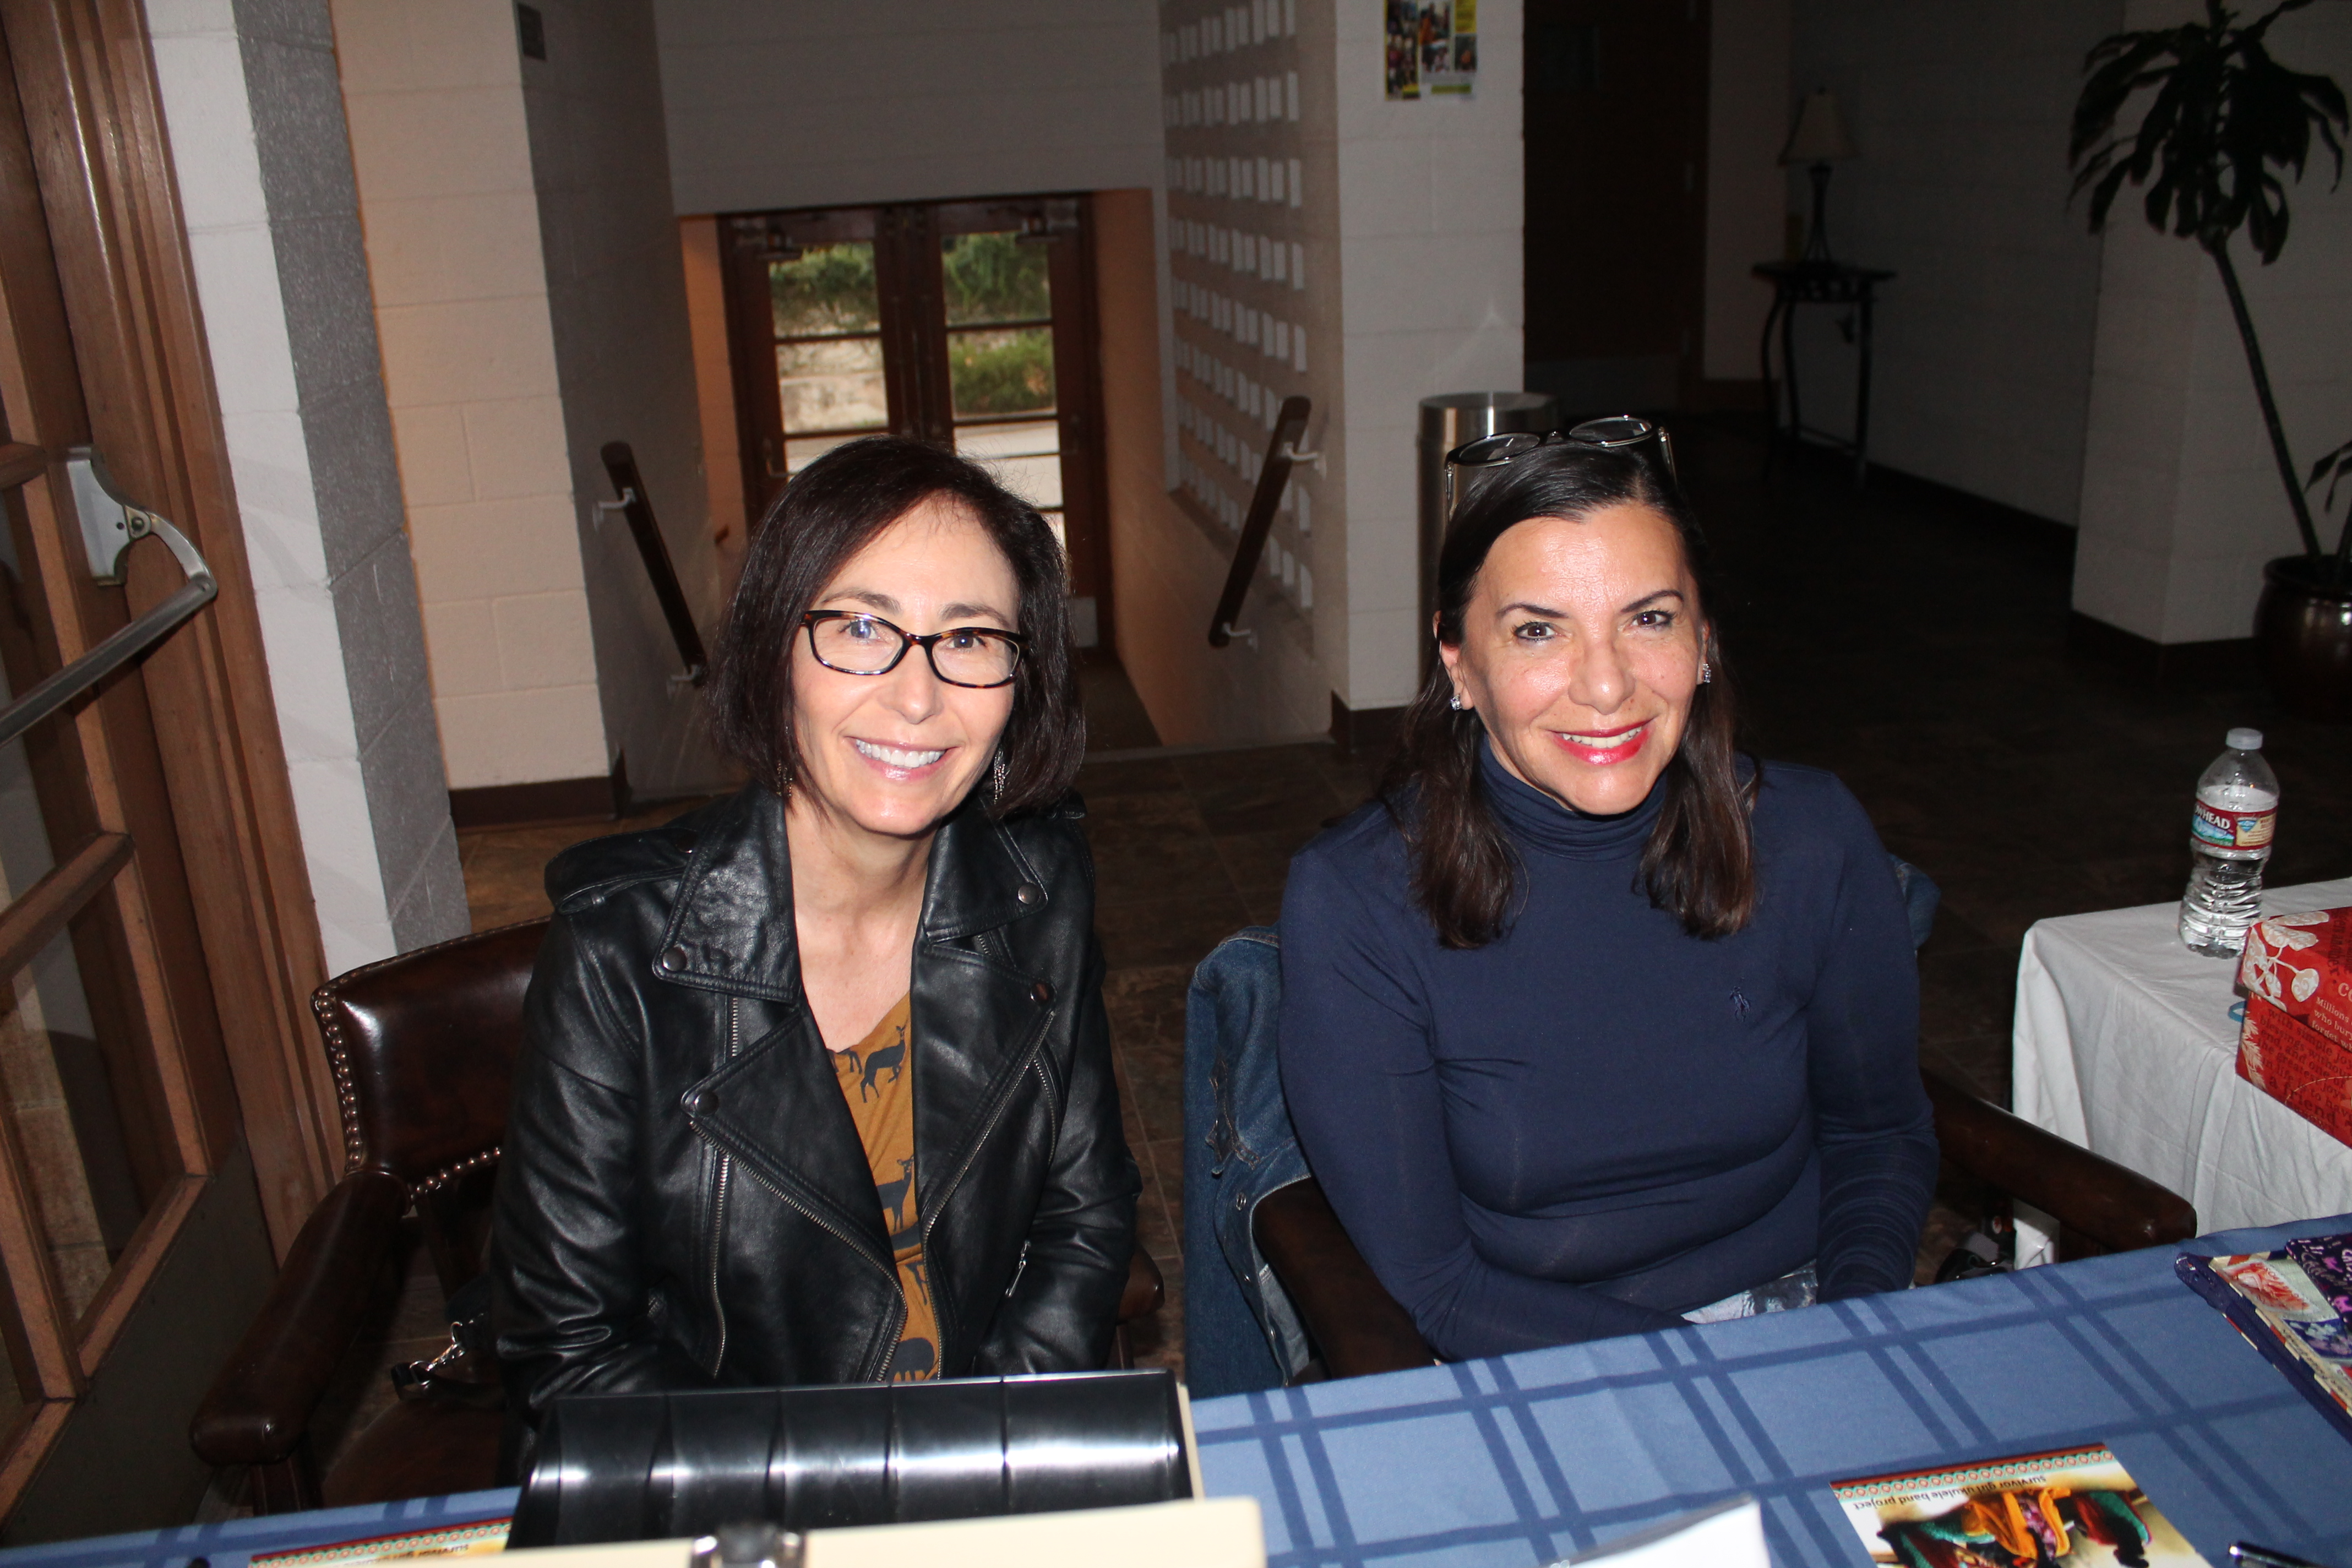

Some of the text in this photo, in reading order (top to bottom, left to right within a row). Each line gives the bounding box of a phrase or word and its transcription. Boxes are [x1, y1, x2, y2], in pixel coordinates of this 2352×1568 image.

[2195, 804, 2230, 830] WHEAD
[2314, 1010, 2333, 1026] who
[2316, 996, 2350, 1023] Millions
[2260, 1015, 2305, 1052] blessings
[2268, 1009, 2293, 1030] with
[2297, 1027, 2333, 1057] simple
[2312, 1020, 2339, 1042] forget
[2258, 1038, 2346, 1100] the greatest joys
[2285, 1047, 2307, 1064] and
[2309, 1061, 2330, 1077] one
[2262, 1057, 2273, 1070] in
[2277, 1063, 2294, 1083] life
[2311, 1087, 2322, 1101] to
[2269, 1076, 2278, 1089] a
[1853, 1474, 2047, 1510] survivor girl ukulele band project
